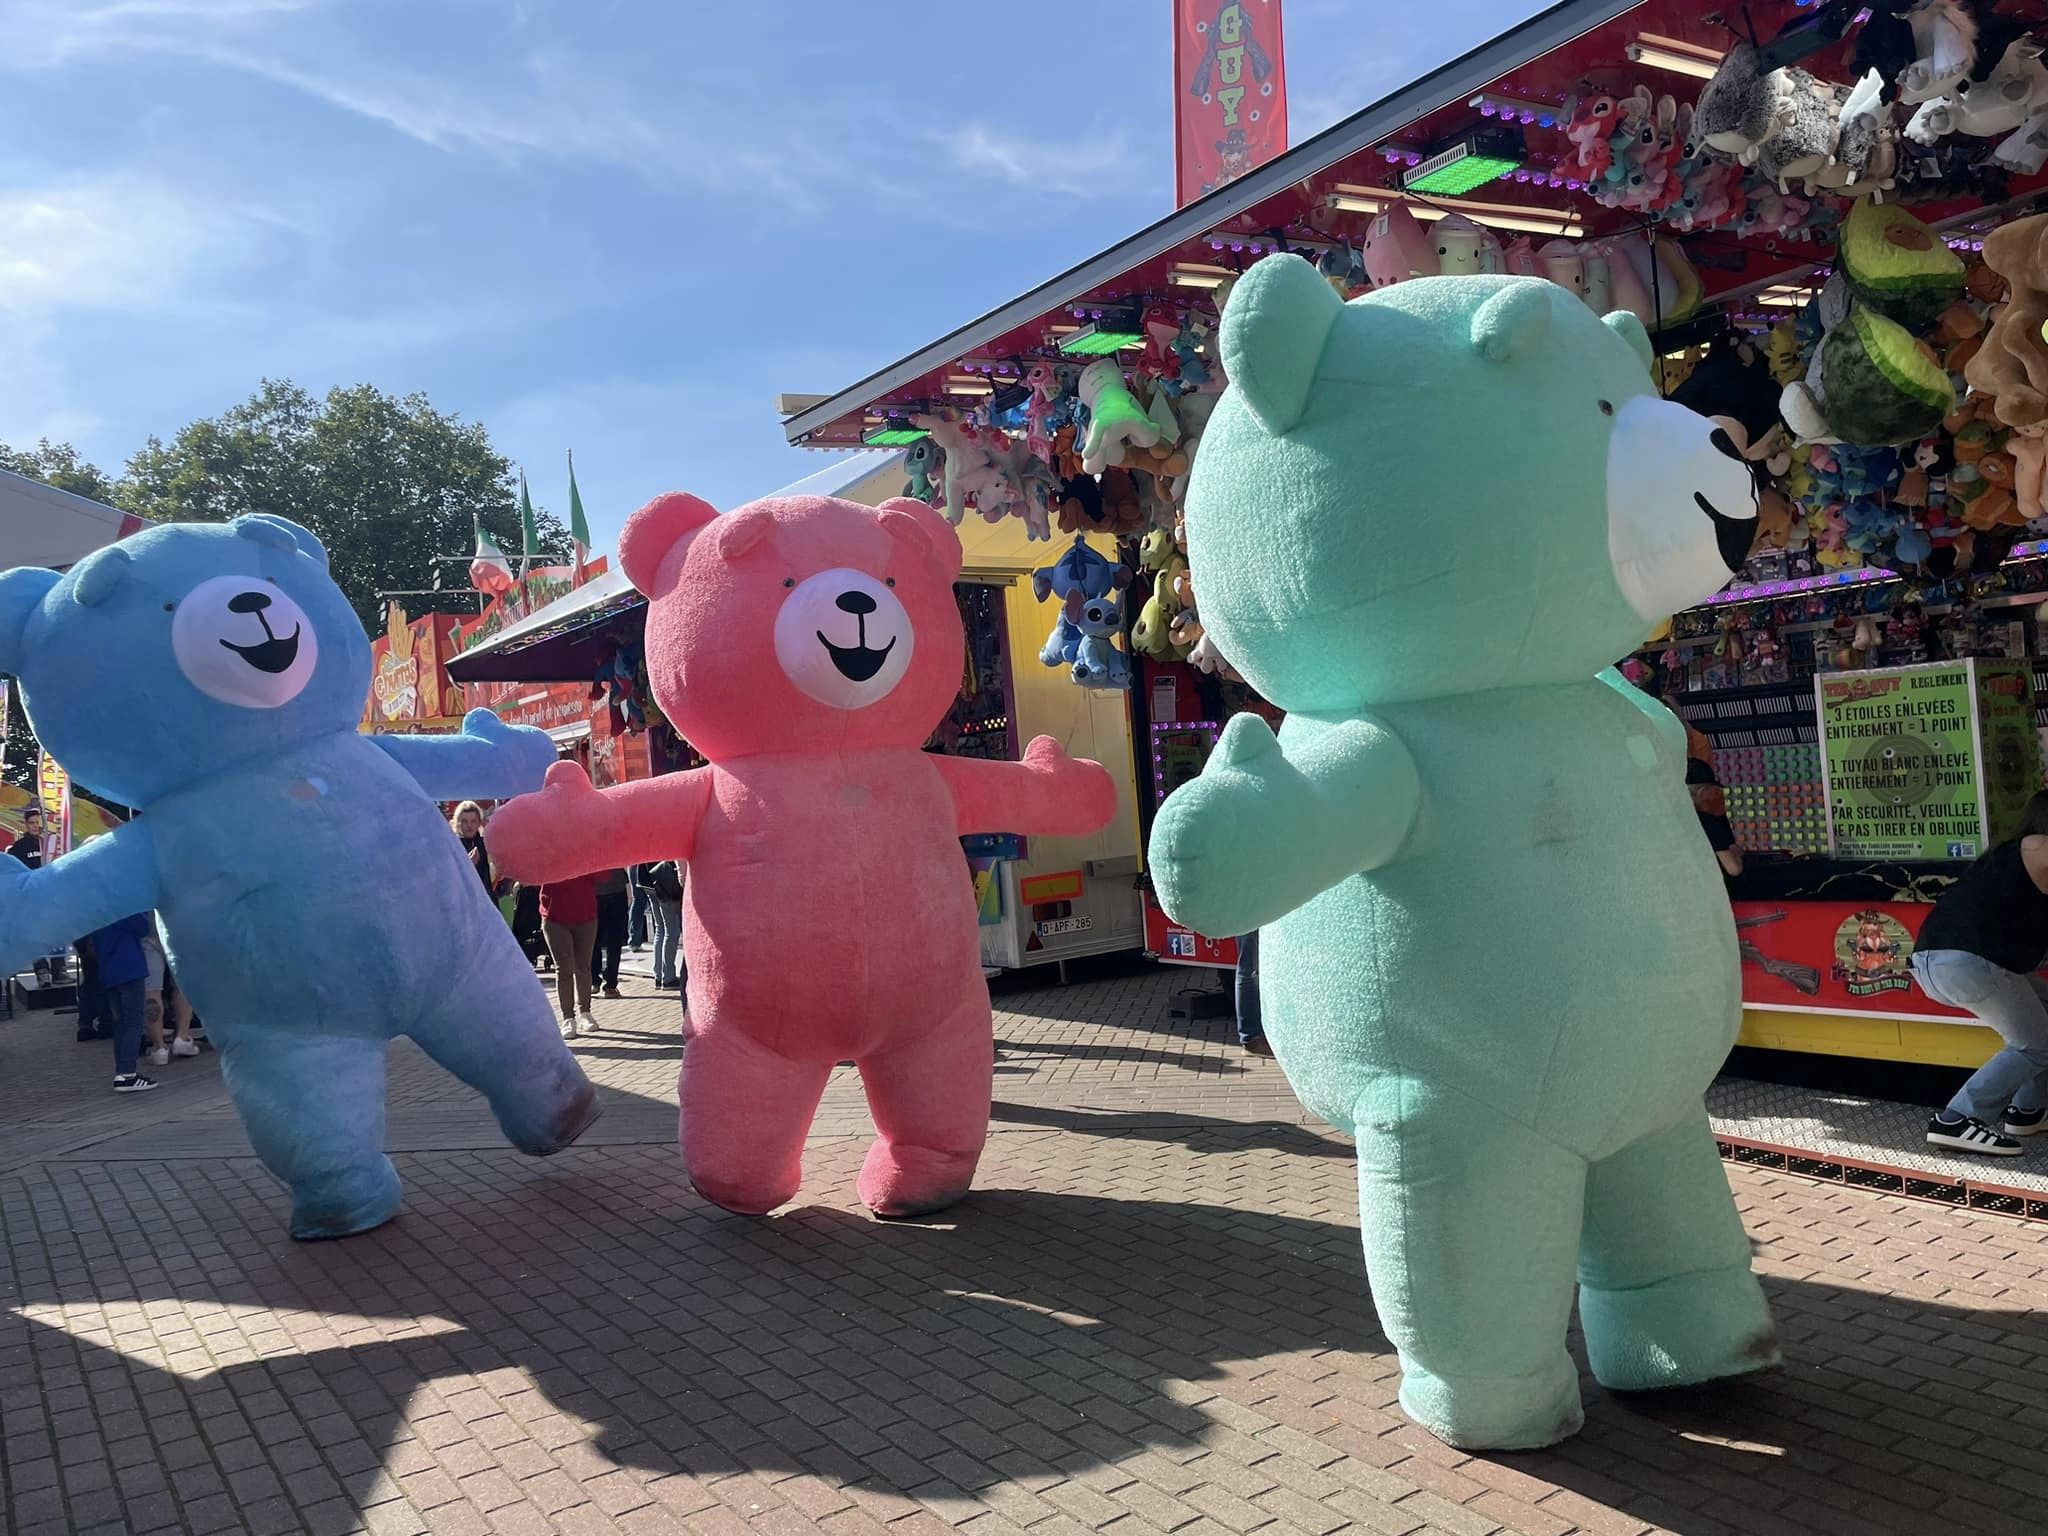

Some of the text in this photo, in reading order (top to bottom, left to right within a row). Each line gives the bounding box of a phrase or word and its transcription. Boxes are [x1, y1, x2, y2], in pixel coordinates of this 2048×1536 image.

[1834, 707, 1842, 722] 3
[1920, 718, 1928, 733] 1
[1932, 716, 1967, 732] POINT
[1830, 759, 1838, 773] 1
[1840, 757, 1878, 773] TUYAU
[1882, 755, 1919, 770] BLANC
[1924, 772, 1931, 786] 1
[1936, 770, 1972, 786] POINT
[1832, 805, 1853, 820] PAR
[1920, 802, 1976, 818] VEUILLEZ
[1848, 823, 1870, 837] PAS
[1875, 822, 1906, 837] TIRER
[1911, 822, 1925, 836] EN
[1929, 820, 1981, 837] OBLIQUE
